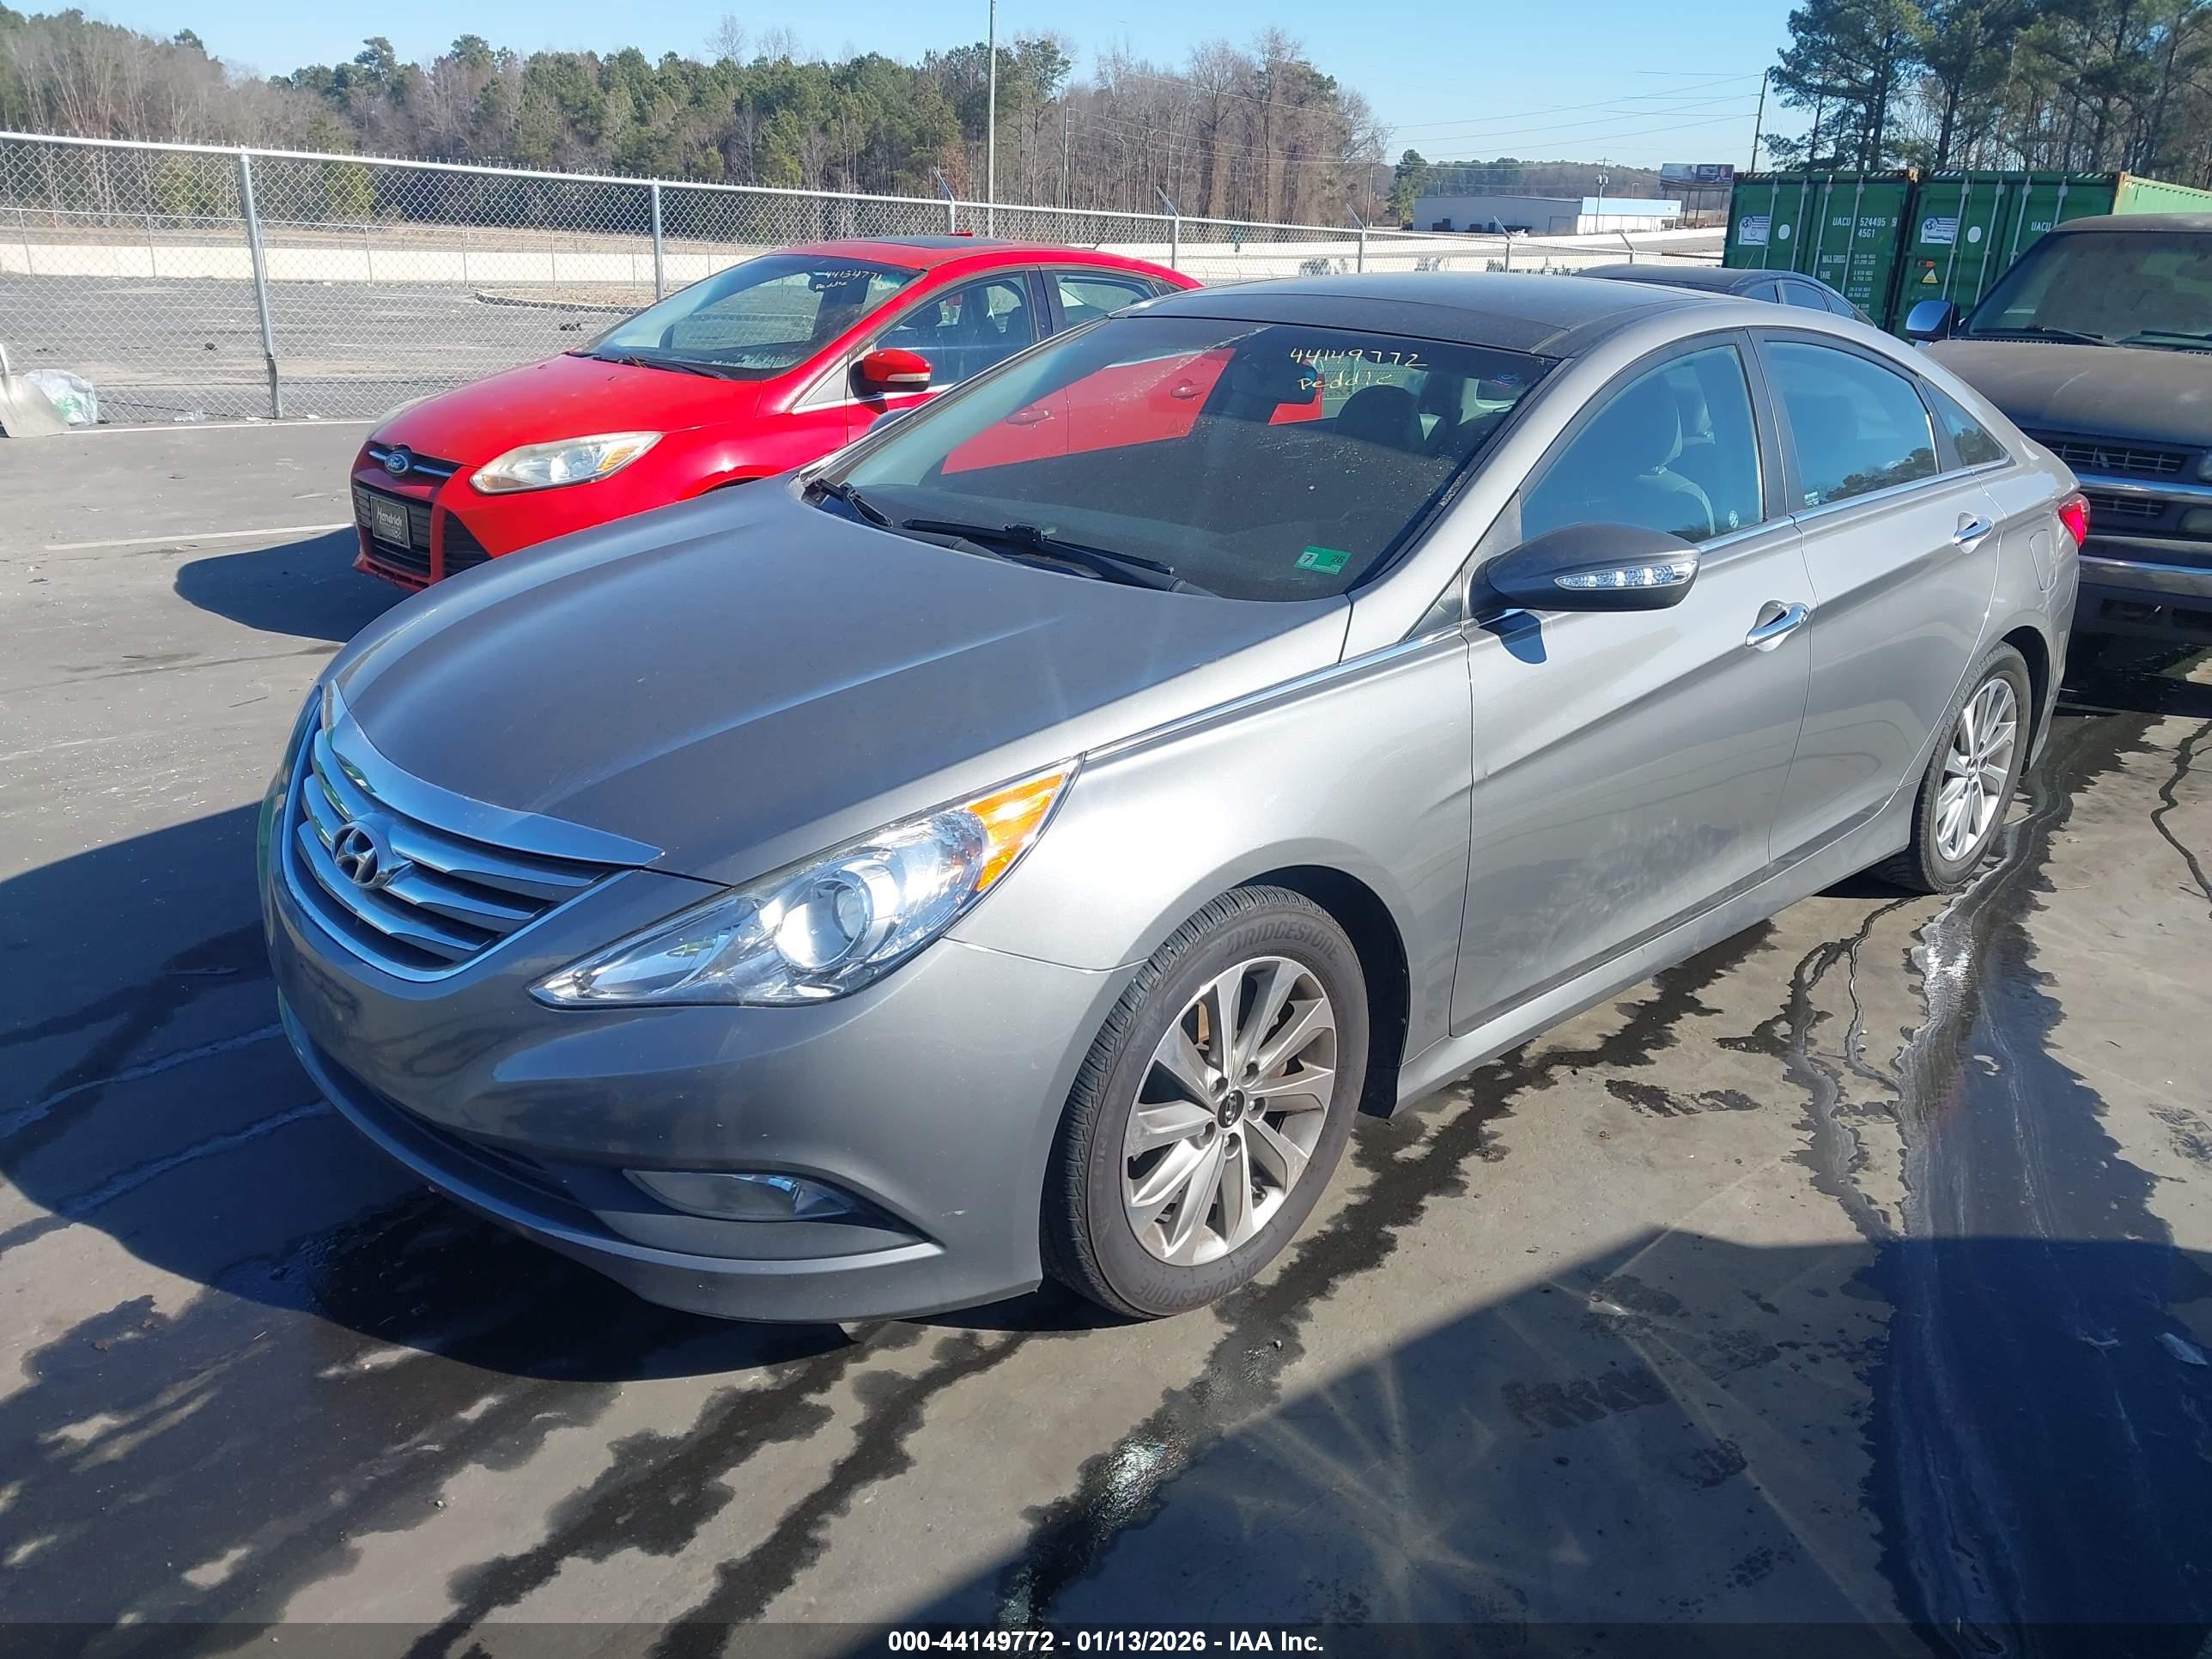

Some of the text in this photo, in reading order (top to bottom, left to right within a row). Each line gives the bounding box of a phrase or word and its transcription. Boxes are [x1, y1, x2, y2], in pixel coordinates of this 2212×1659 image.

[1832, 216, 1851, 226] UACU
[1859, 216, 1887, 227] 524495
[2031, 221, 2051, 233] UACU
[1857, 228, 1875, 238] 45G1
[1291, 348, 1428, 367] 44149772
[1304, 554, 1346, 564] 7 26
[1226, 920, 1341, 959] BRIDGESTONE
